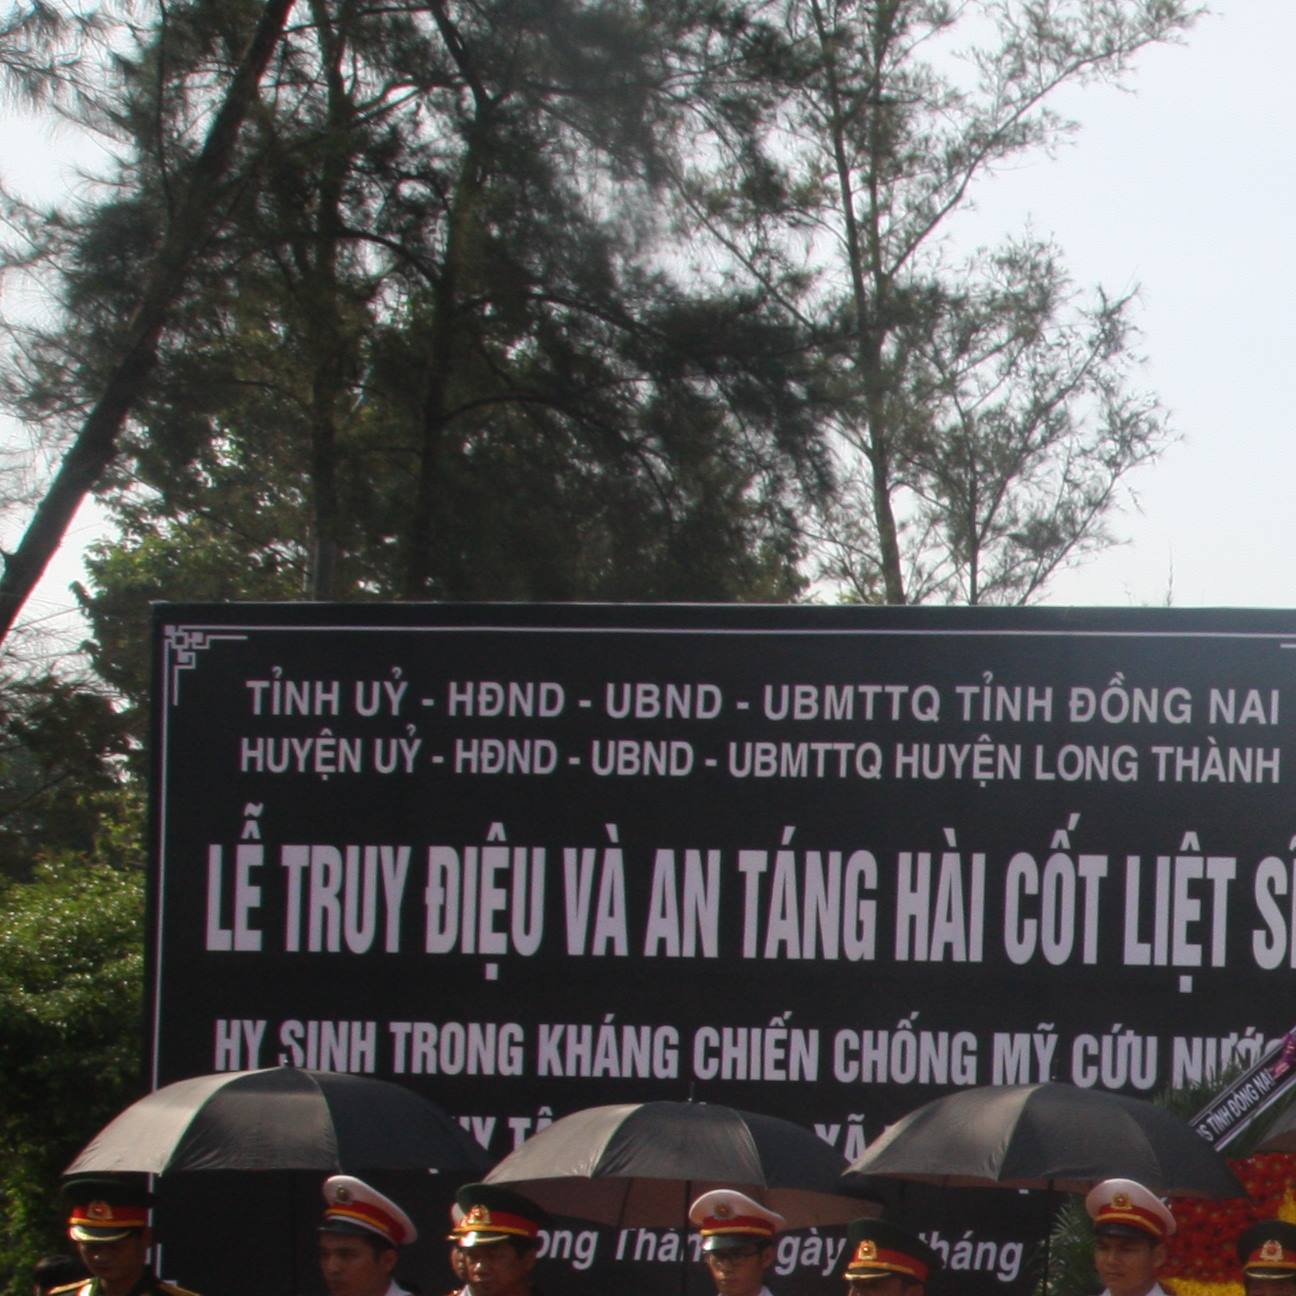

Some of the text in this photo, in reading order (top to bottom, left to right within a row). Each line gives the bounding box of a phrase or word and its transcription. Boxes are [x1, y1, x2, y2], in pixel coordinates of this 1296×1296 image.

[246, 666, 340, 716] TỈNH
[355, 666, 407, 717] UỶ
[448, 682, 565, 717] HĐND
[606, 683, 722, 719] UBND
[764, 684, 940, 722] UBMTTQ
[956, 671, 1053, 723] TỈNH
[1069, 672, 1193, 725] ĐỒNG
[1209, 688, 1280, 725] NAI
[241, 728, 362, 781] HUYỆN
[374, 723, 422, 774] UỶ
[455, 738, 558, 775] HĐND
[591, 739, 696, 777] UBND
[729, 742, 882, 781] UBMTTQ
[896, 735, 1021, 788] HUYỆN
[1035, 745, 1139, 783] LONG
[1151, 737, 1280, 784] THÀNH
[206, 802, 264, 952] LỄ
[282, 845, 411, 955] TRUY
[425, 822, 546, 981] ĐIỆU
[562, 823, 629, 957] VÀ
[644, 848, 722, 958] AN
[737, 826, 878, 961] TÁNG
[895, 827, 986, 963] HÀI
[1004, 812, 1107, 965] CỐT
[1123, 831, 1236, 993] LIỆT
[214, 1010, 1285, 1090] HY SINH TRONG KHÁNG CHIẾN CHỐNG MỸ CỨU NƯỚ
